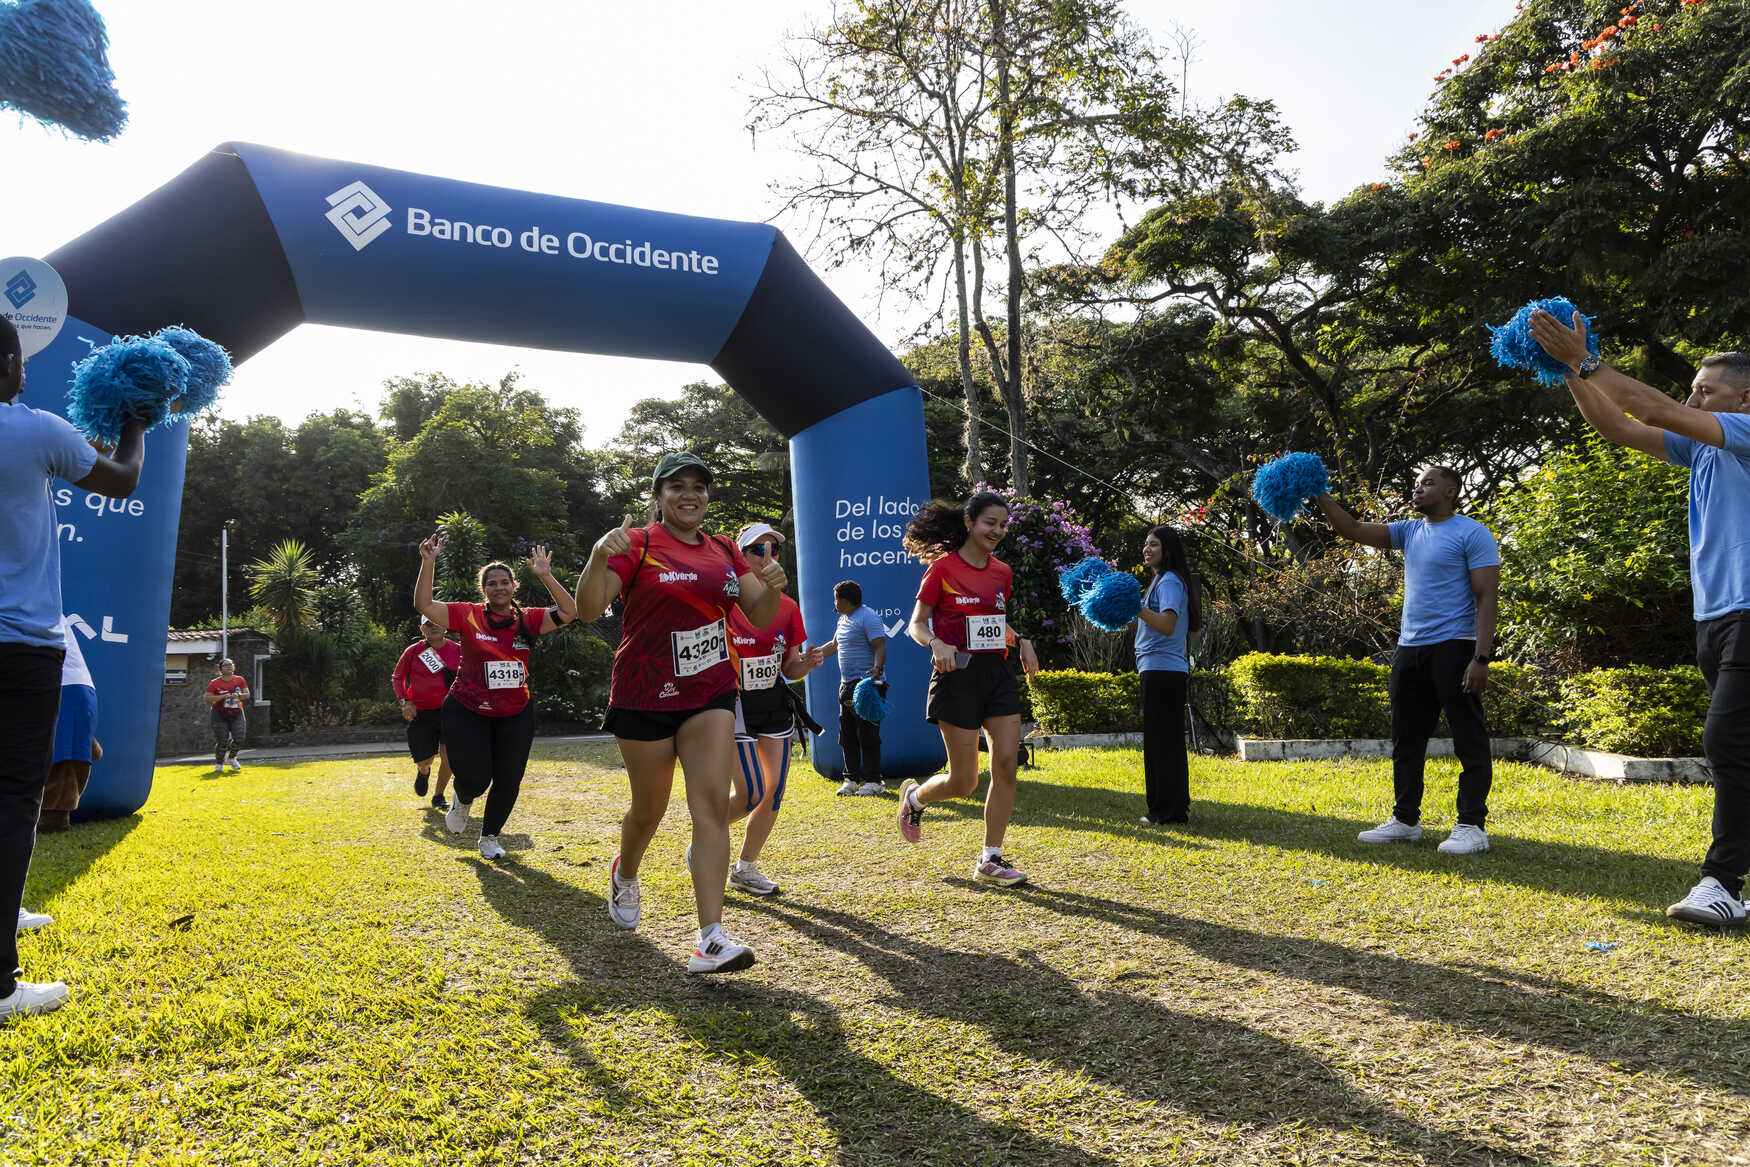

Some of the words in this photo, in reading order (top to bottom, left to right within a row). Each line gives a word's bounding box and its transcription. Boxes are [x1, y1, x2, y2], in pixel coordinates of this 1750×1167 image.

[407, 207, 512, 249] Banco
[520, 226, 559, 255] de
[567, 231, 720, 275] Occidente
[15, 312, 57, 323] Occidente
[85, 492, 145, 517] que
[835, 496, 871, 519] Del
[879, 495, 920, 517] lado
[836, 521, 865, 542] de
[872, 519, 902, 539] los
[839, 548, 912, 569] hacen.
[876, 608, 901, 618] upo
[976, 625, 1001, 638] 480
[679, 635, 719, 661] 4320
[421, 651, 440, 671] 2000
[489, 669, 519, 680] 4318
[747, 664, 777, 680] 1803
